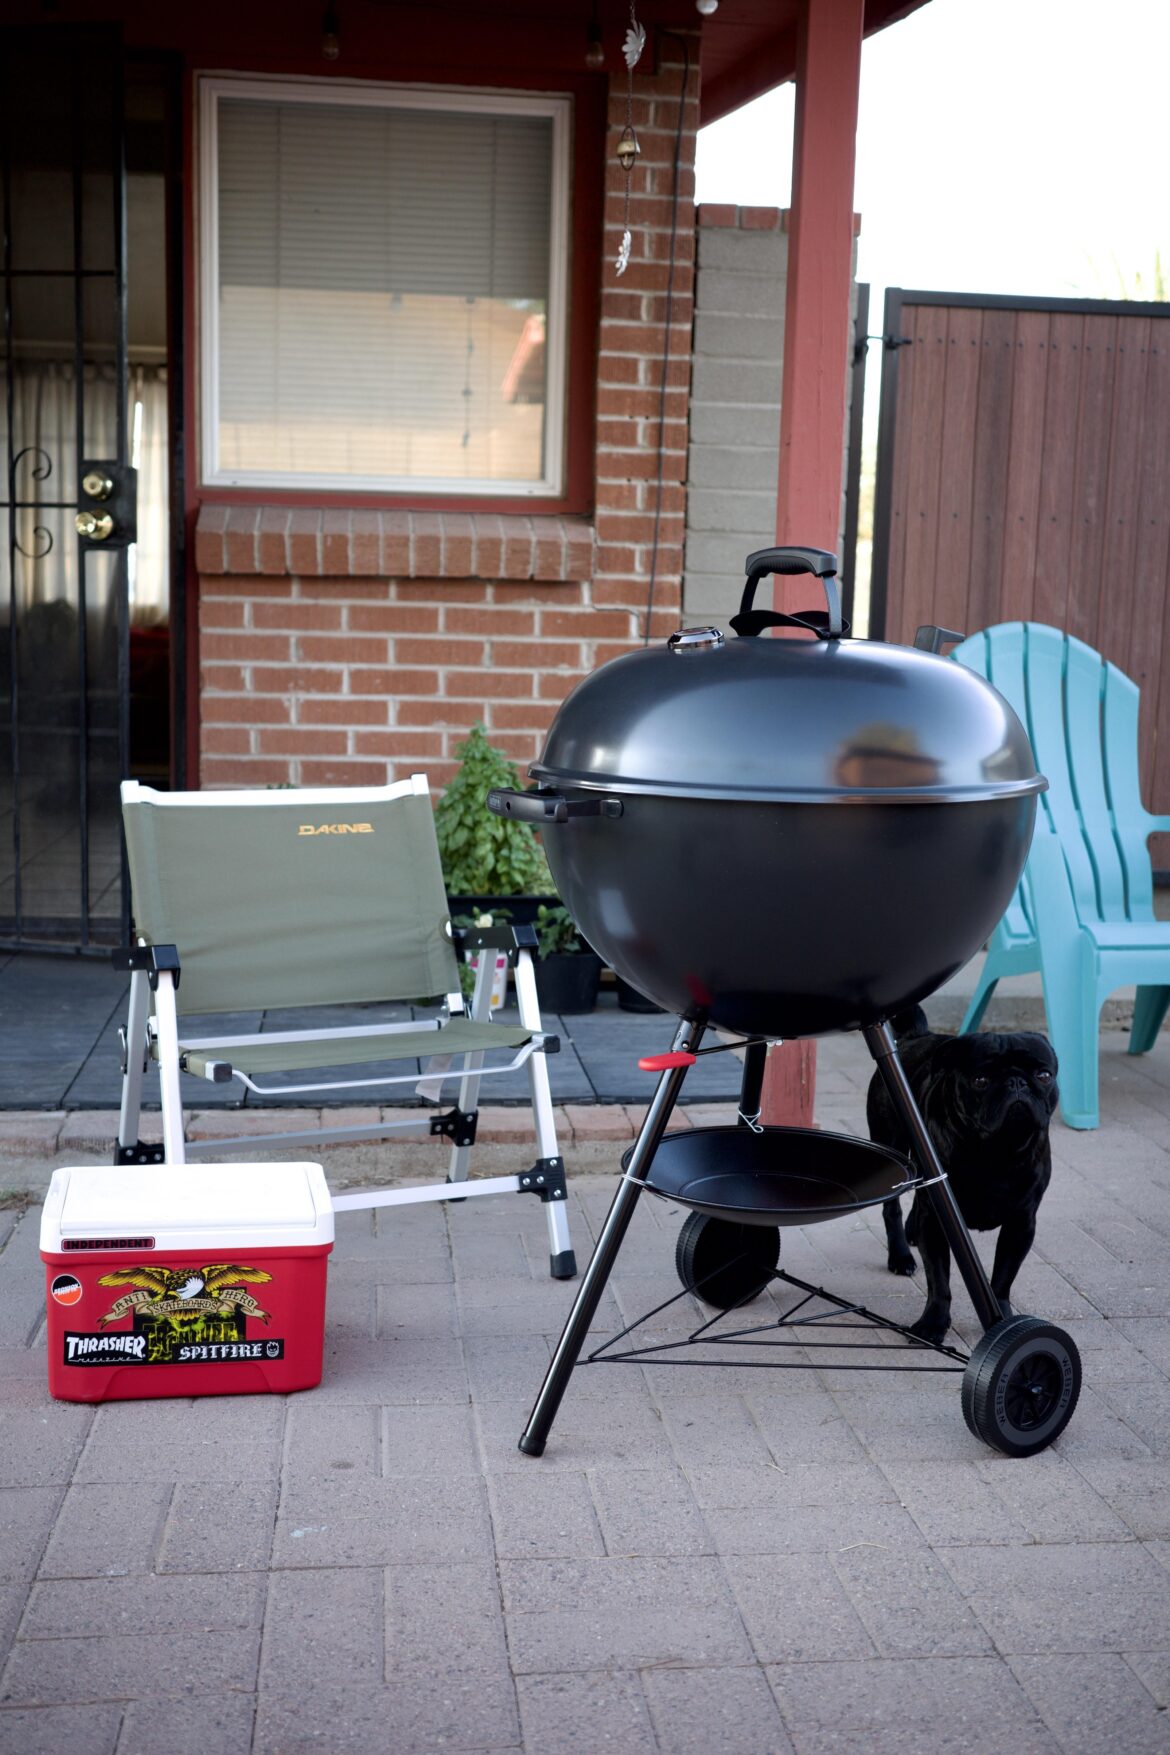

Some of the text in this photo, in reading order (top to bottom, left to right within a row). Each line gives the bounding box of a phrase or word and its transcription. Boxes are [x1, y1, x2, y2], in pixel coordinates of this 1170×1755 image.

[298, 823, 374, 835] DAKINE
[66, 1239, 149, 1249] INDEPENDENT
[115, 1289, 255, 1311] ANTI HERO
[152, 1300, 218, 1315] SKATEBOARDS
[66, 1336, 146, 1359] THRASHER
[178, 1343, 263, 1360] SPITFIRE
[1060, 1356, 1073, 1409] WEBER
